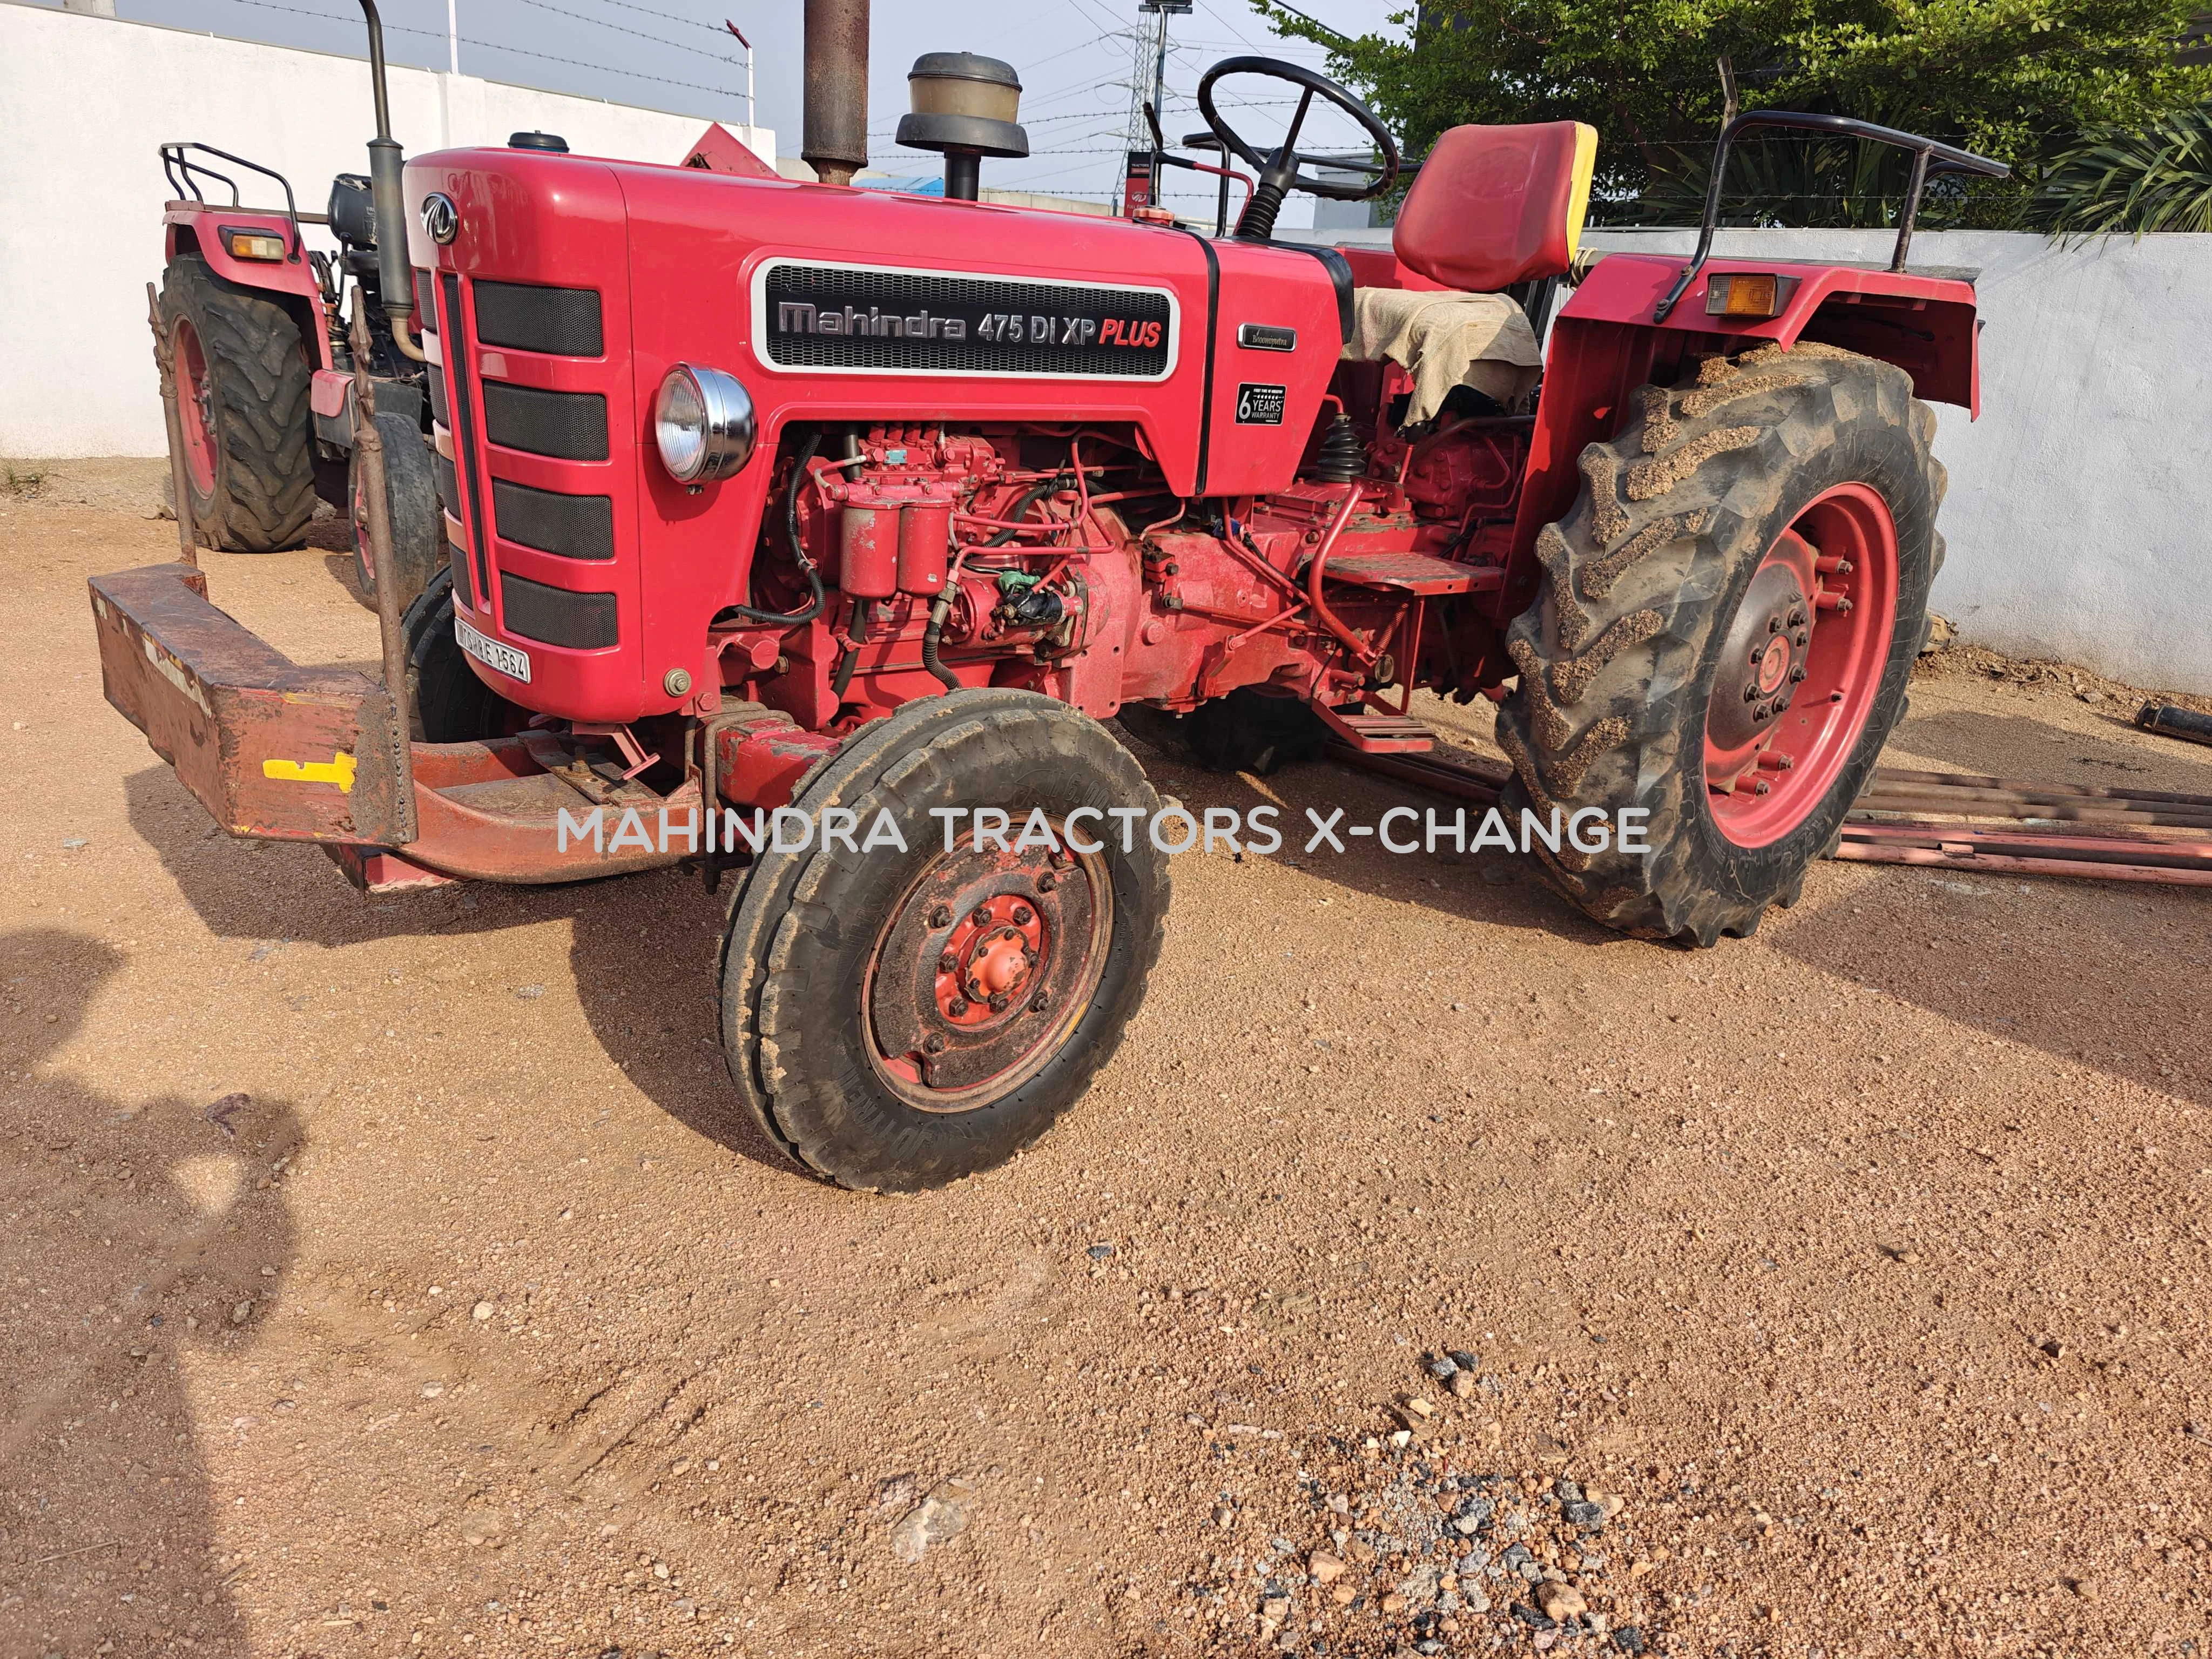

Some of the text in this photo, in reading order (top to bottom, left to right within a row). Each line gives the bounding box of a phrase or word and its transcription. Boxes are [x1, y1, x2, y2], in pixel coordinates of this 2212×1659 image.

[779, 301, 1162, 347] Mahindra 475 DI XP PLUS
[1239, 391, 1251, 420] 6
